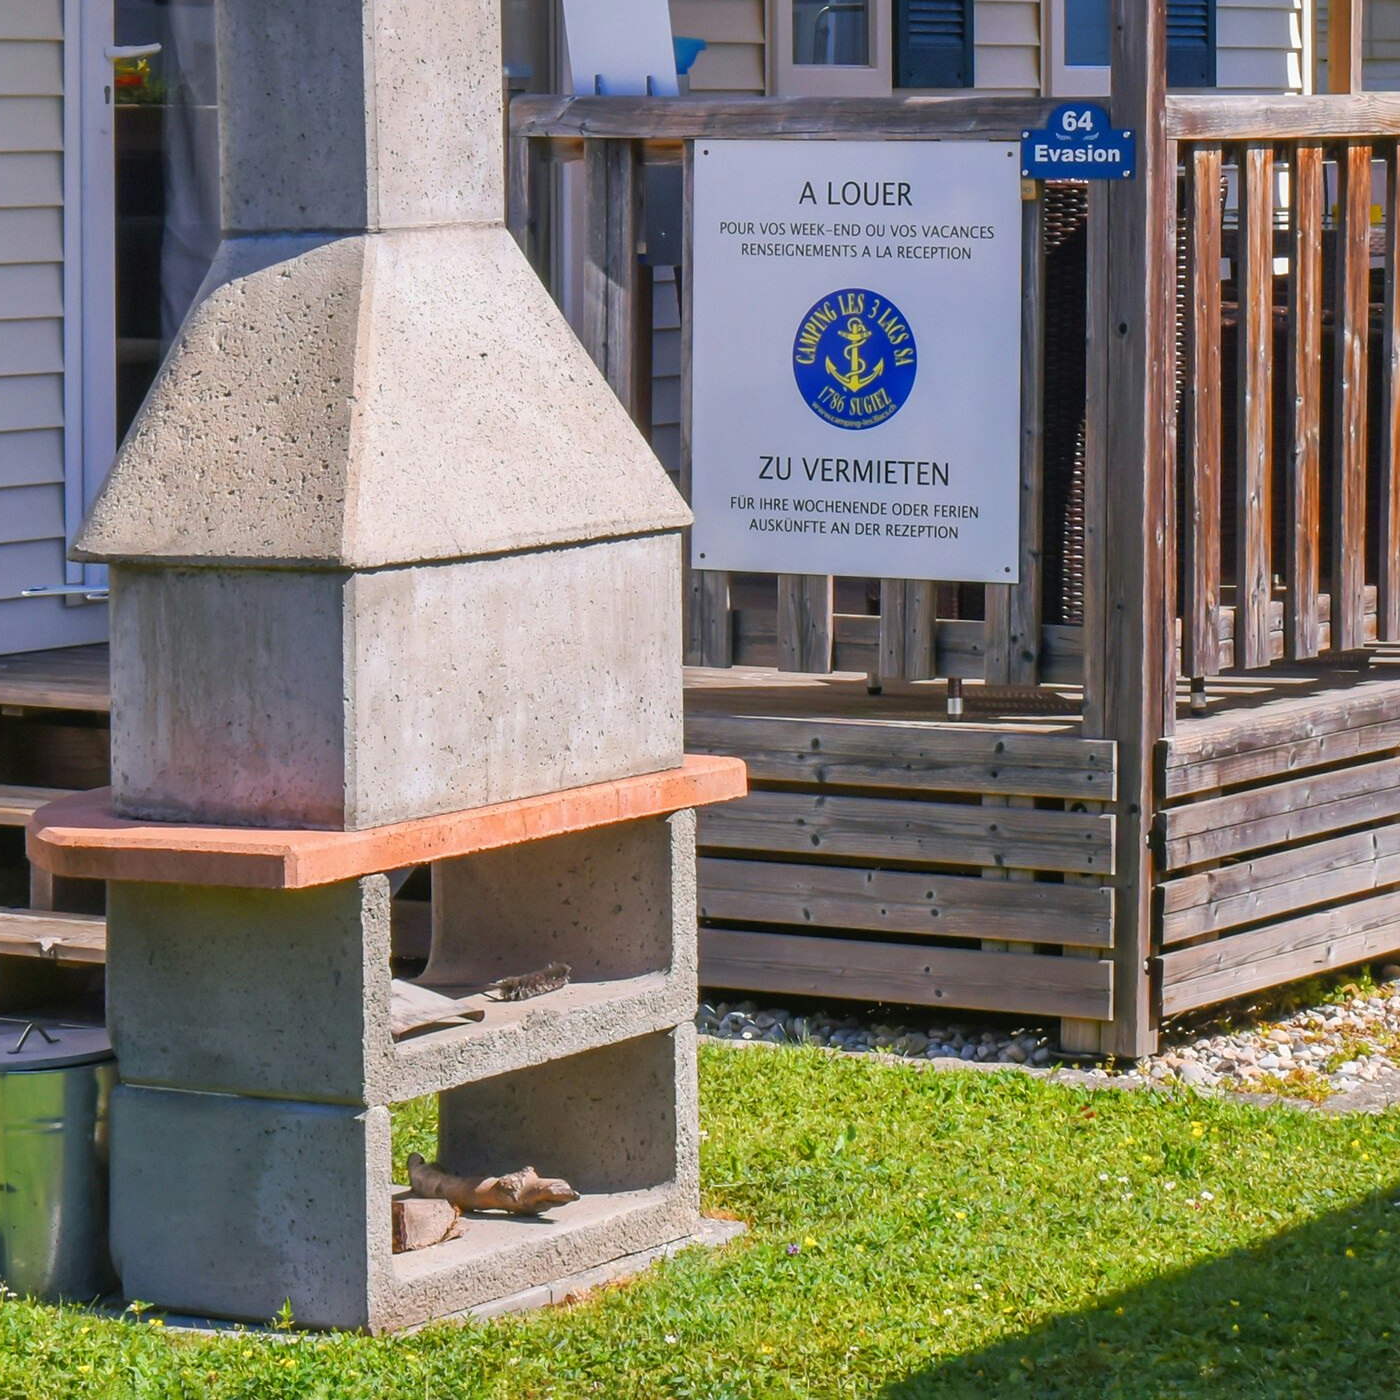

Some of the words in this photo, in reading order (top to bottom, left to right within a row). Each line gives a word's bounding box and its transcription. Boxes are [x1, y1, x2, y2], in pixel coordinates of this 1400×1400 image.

[1062, 110, 1093, 132] 64
[1034, 144, 1120, 162] Evasion
[798, 180, 818, 205] A
[827, 180, 913, 207] LOUER
[719, 221, 755, 235] POUR
[759, 222, 786, 236] VOS
[790, 222, 861, 237] WEEK-END
[865, 223, 886, 238] OU
[890, 224, 917, 238] VOS
[921, 225, 995, 240] VACANCES
[741, 243, 858, 258] RENSEIGNEMENTS
[861, 245, 872, 258] A
[876, 245, 893, 258] LA
[897, 246, 972, 260] RECEPTION
[837, 293, 865, 316] LES
[868, 299, 880, 318] 3
[795, 301, 838, 365] CAMPING
[877, 307, 910, 345] LACS
[893, 347, 914, 367] SA
[817, 386, 846, 413] 1786
[849, 387, 892, 416] SUGIEZ
[758, 455, 792, 481] ZU
[801, 456, 949, 487] VERMIETEN
[730, 494, 756, 510] FÜR
[759, 497, 790, 512] IHRE
[793, 499, 888, 516] WOCHENENDE
[891, 503, 929, 517] ODER
[933, 504, 979, 519] FERIEN
[749, 517, 827, 534] AUSKÜNFTE
[830, 521, 850, 535] AN
[854, 522, 881, 536] DER
[885, 524, 959, 540] REZEPTION
